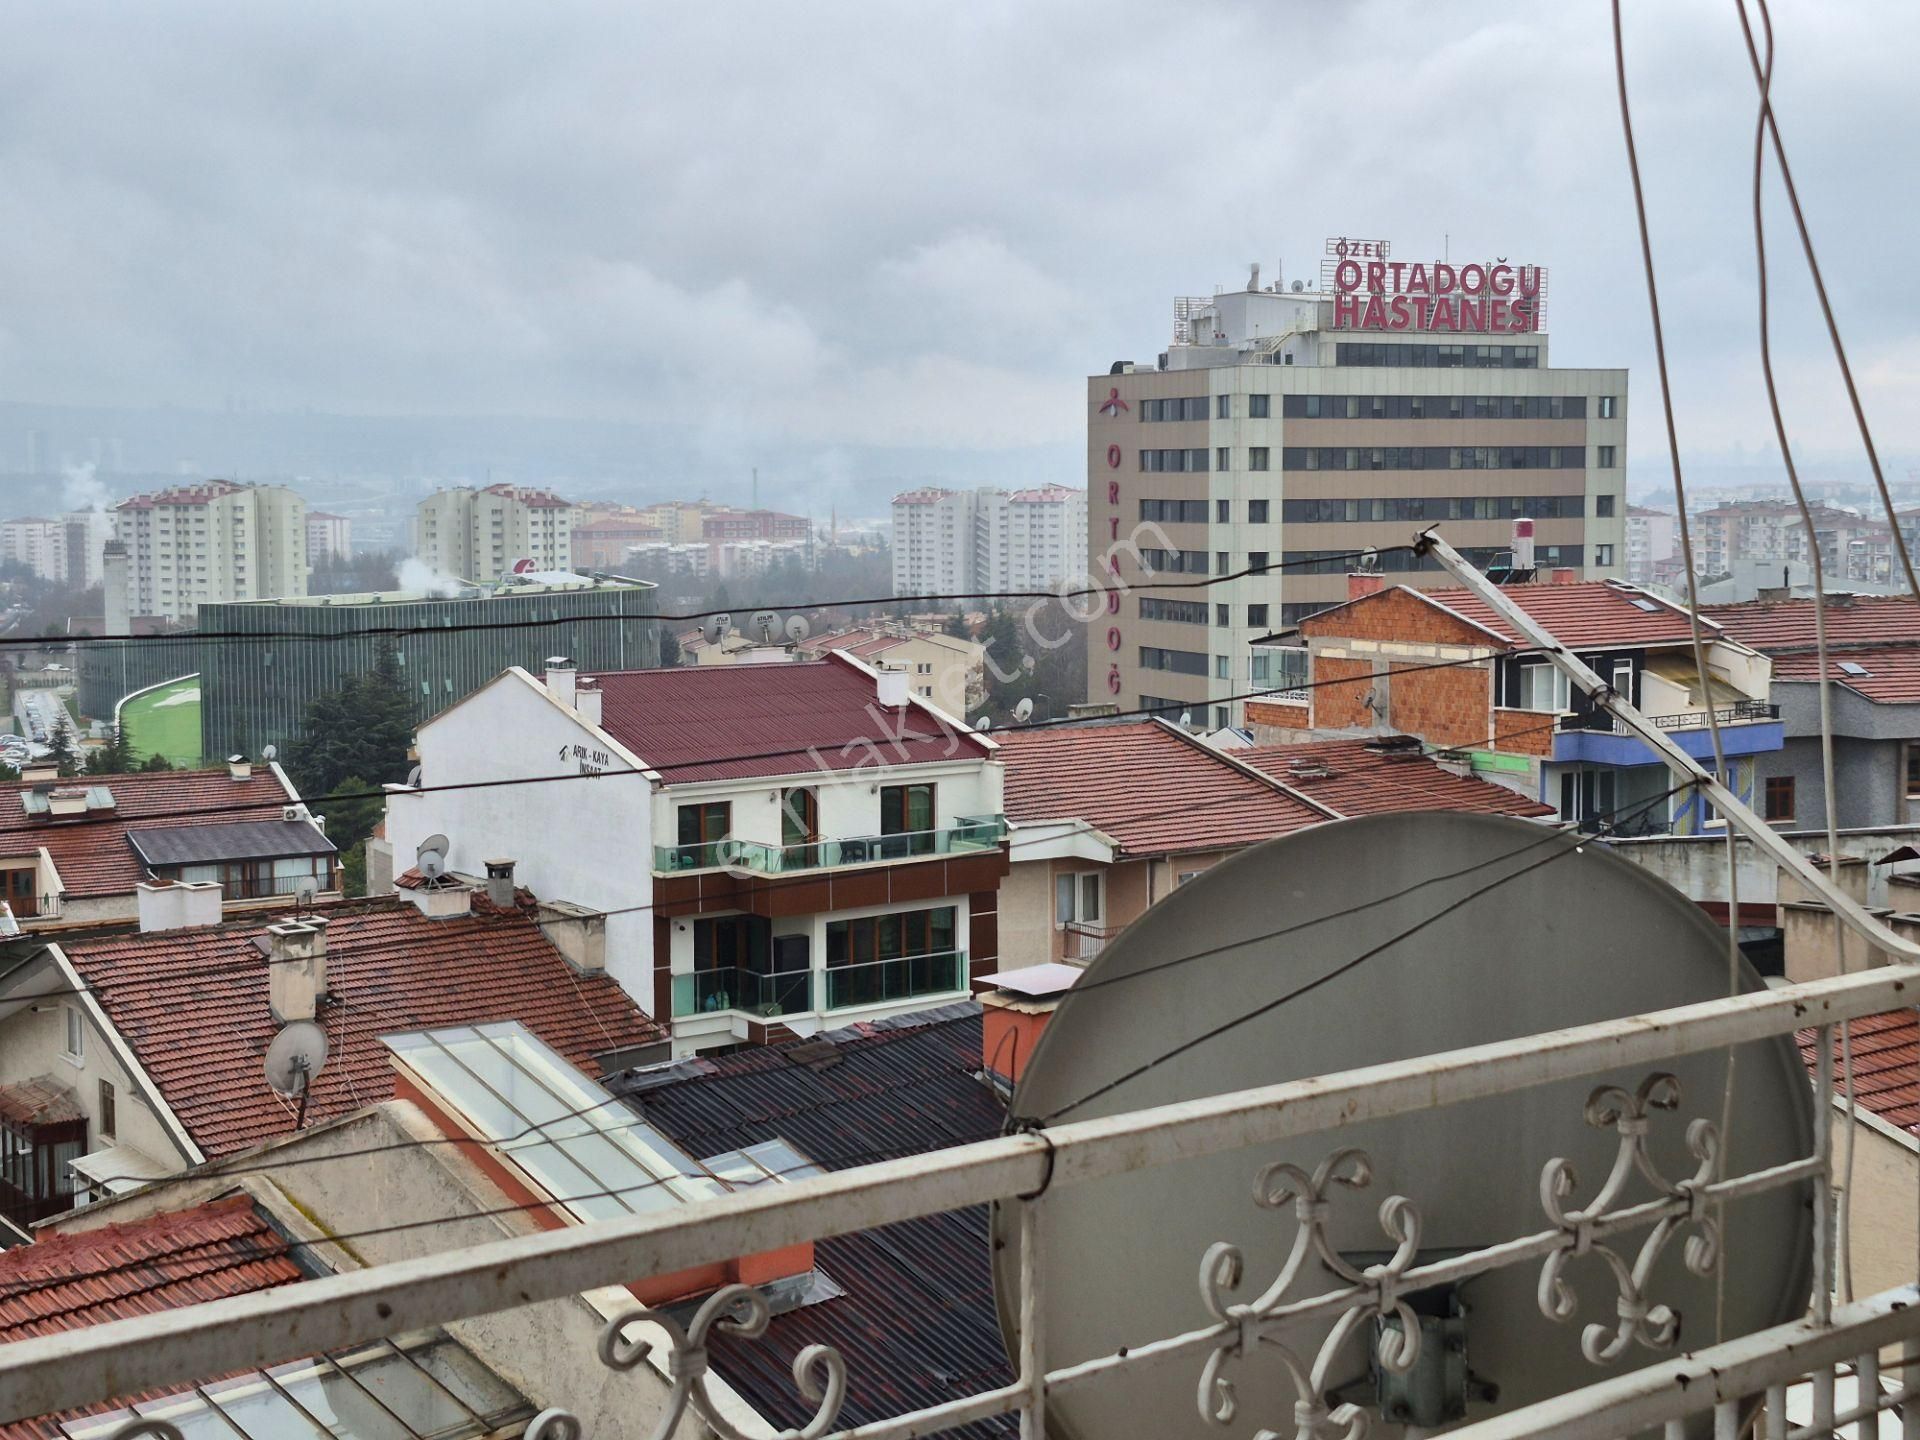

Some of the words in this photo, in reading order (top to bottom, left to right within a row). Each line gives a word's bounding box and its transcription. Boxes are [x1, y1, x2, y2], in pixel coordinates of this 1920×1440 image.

[1335, 237, 1383, 257] ÖZEL
[1335, 257, 1541, 297] ORTADOĞU
[1333, 294, 1540, 332] HASTANESİ
[1107, 444, 1121, 713] ORTADOĞ
